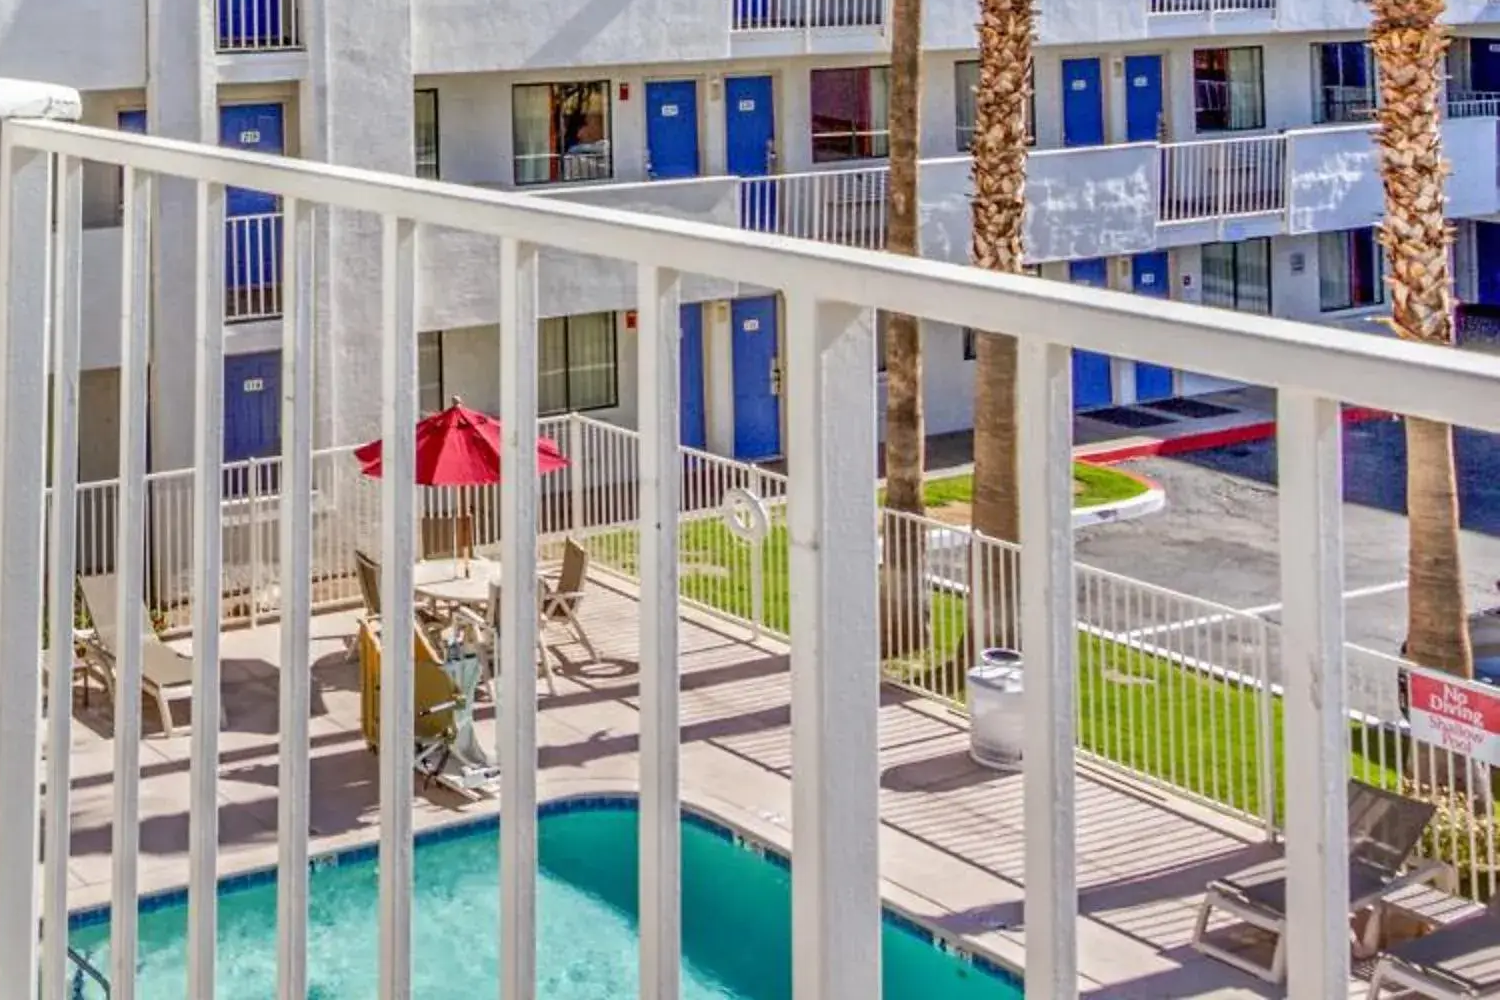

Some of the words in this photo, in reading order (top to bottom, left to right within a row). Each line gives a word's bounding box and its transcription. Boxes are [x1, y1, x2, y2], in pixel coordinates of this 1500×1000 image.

[1443, 684, 1468, 705] No
[1429, 693, 1484, 729] Diving
[1429, 715, 1484, 744] Shallow
[1443, 726, 1472, 753] Pool
